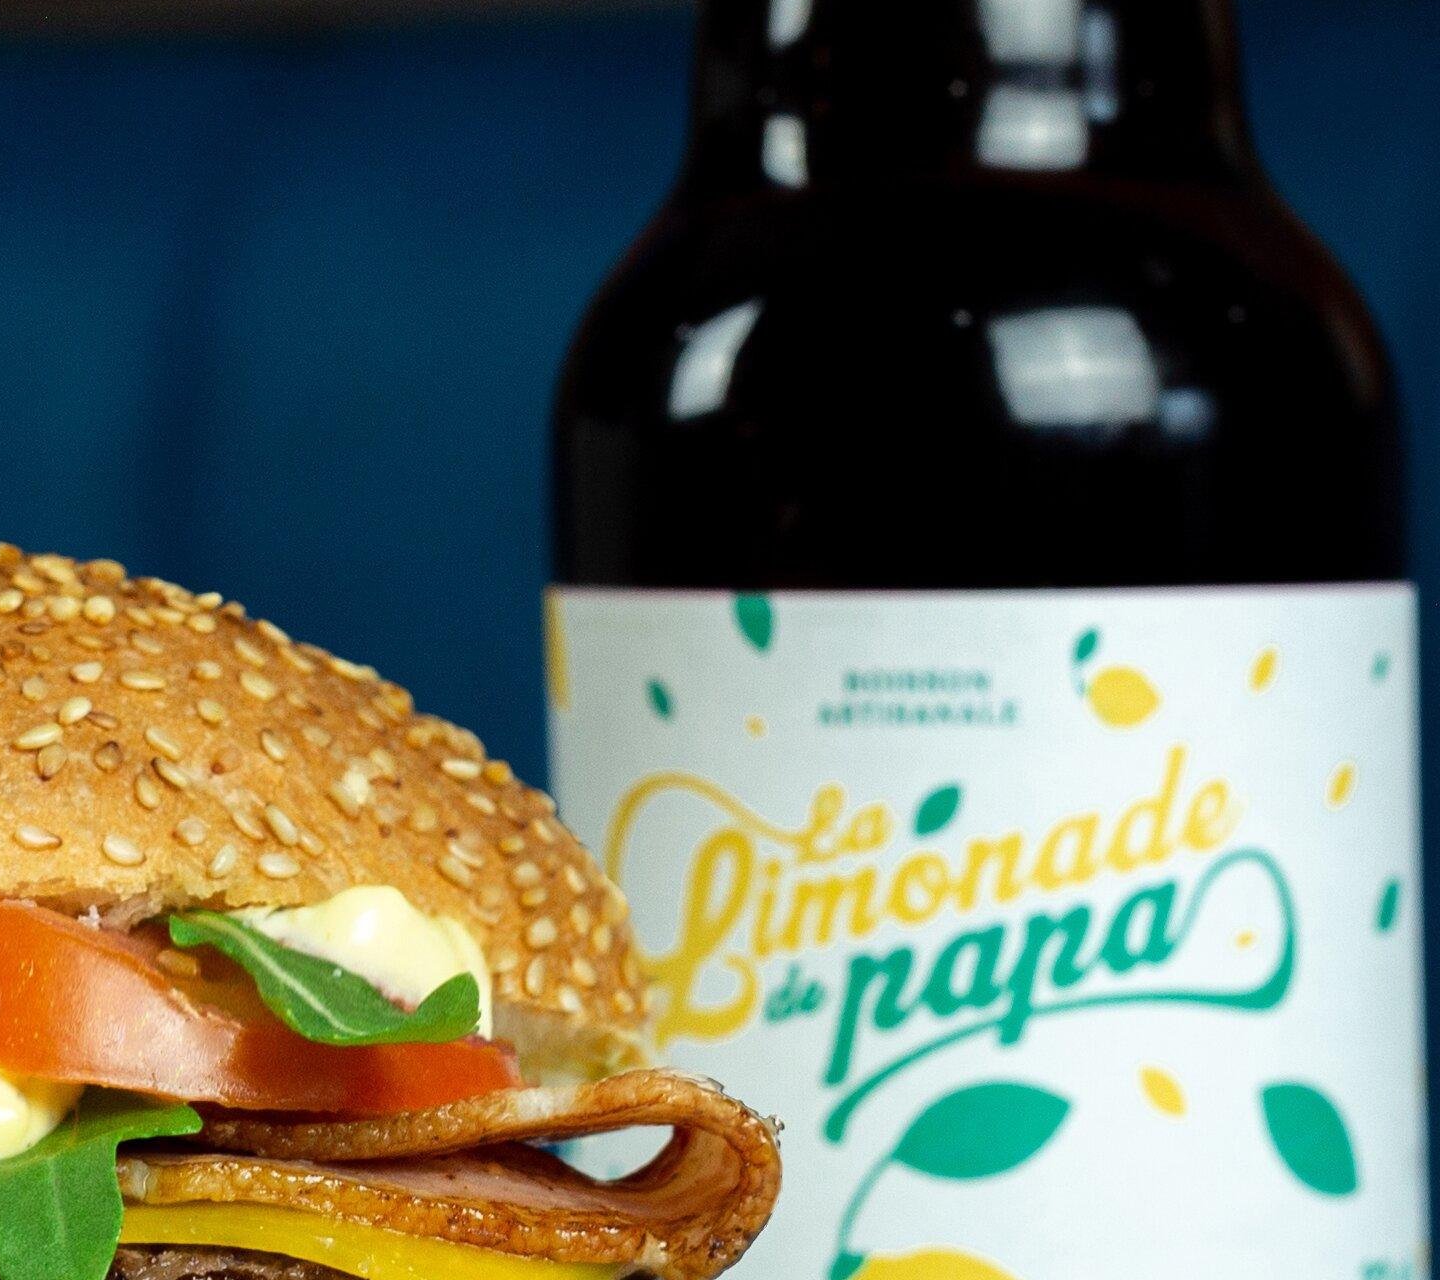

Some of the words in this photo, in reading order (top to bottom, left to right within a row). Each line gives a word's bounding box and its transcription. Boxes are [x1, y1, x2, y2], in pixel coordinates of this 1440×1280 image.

[640, 742, 1236, 1051] Limonade
[762, 960, 829, 1026] de
[821, 877, 1184, 1089] papa
